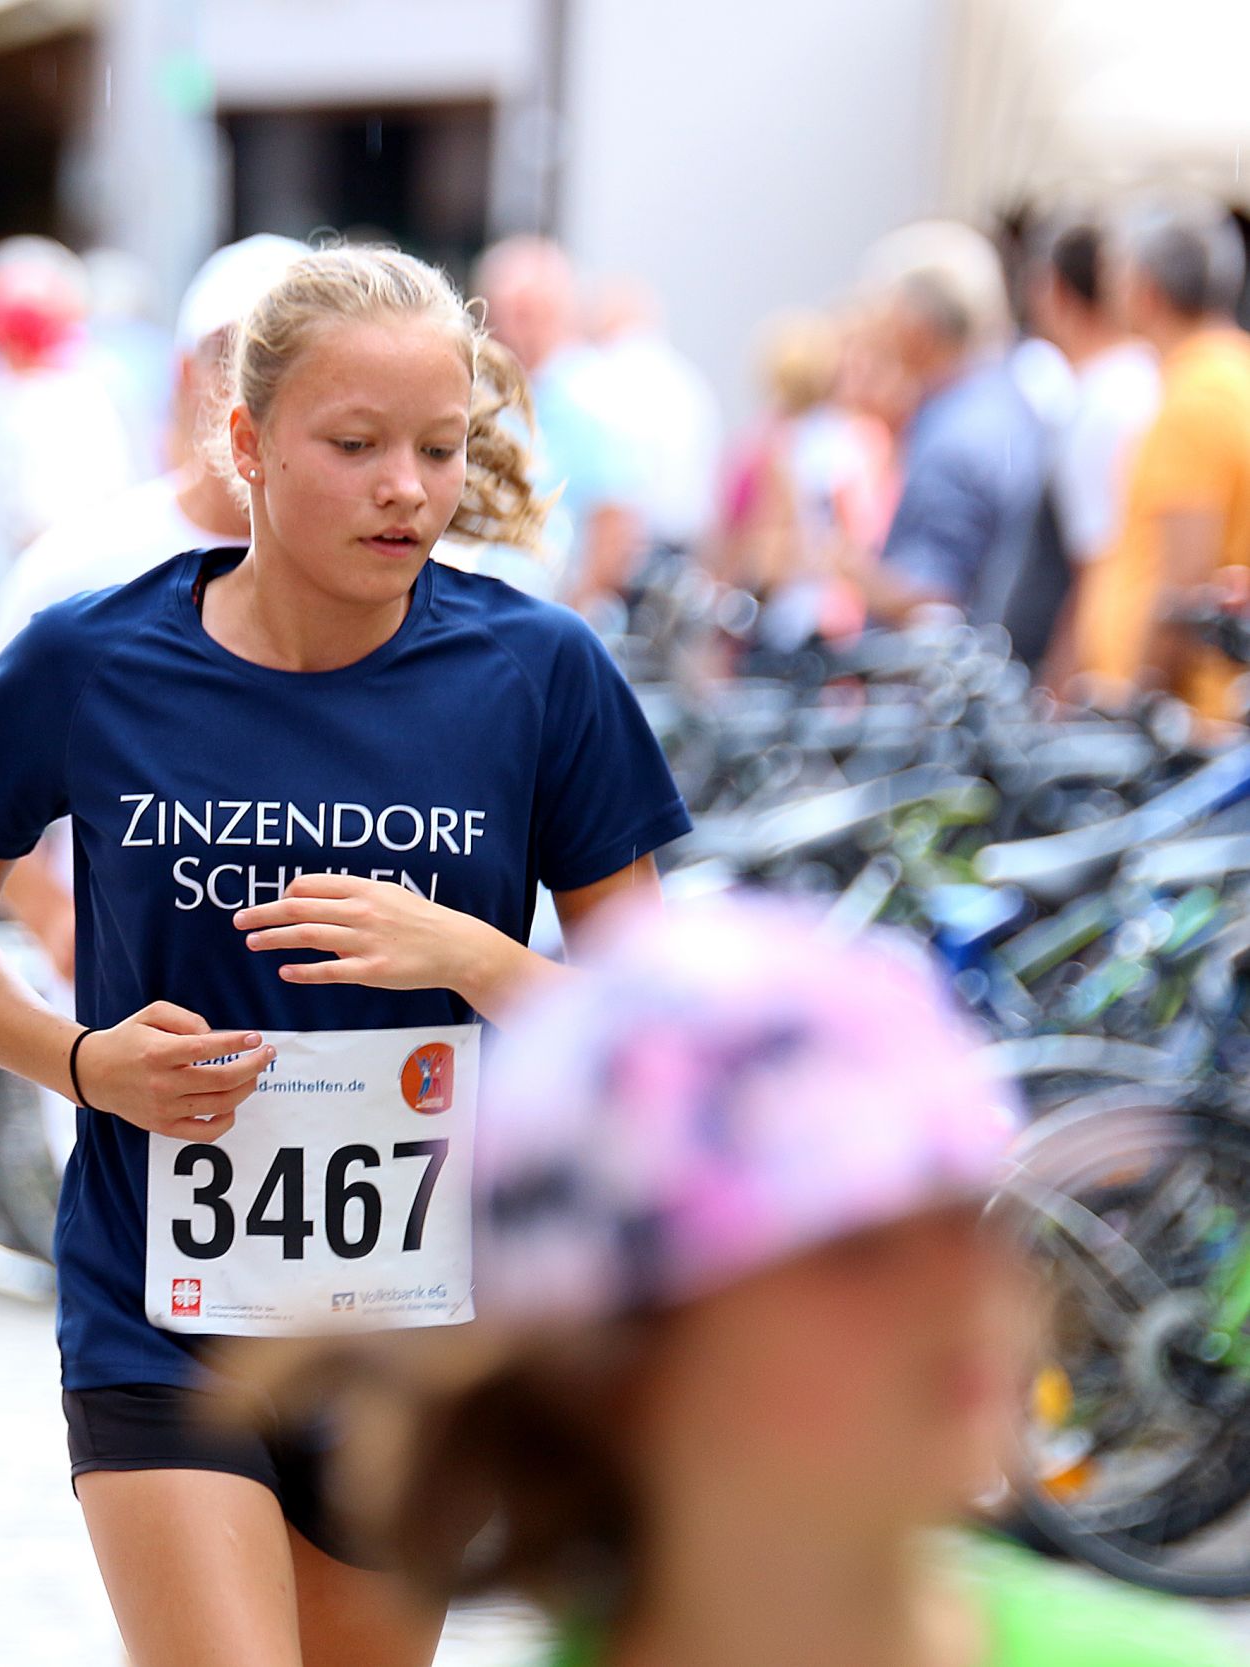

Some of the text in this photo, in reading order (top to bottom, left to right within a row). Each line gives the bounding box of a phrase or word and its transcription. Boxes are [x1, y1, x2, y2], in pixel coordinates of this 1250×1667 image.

[120, 793, 486, 856] ZINZENDORF
[172, 856, 439, 911] SCHN
[254, 1079, 366, 1093] d-mithelfen.de
[171, 1138, 449, 1260] 3467
